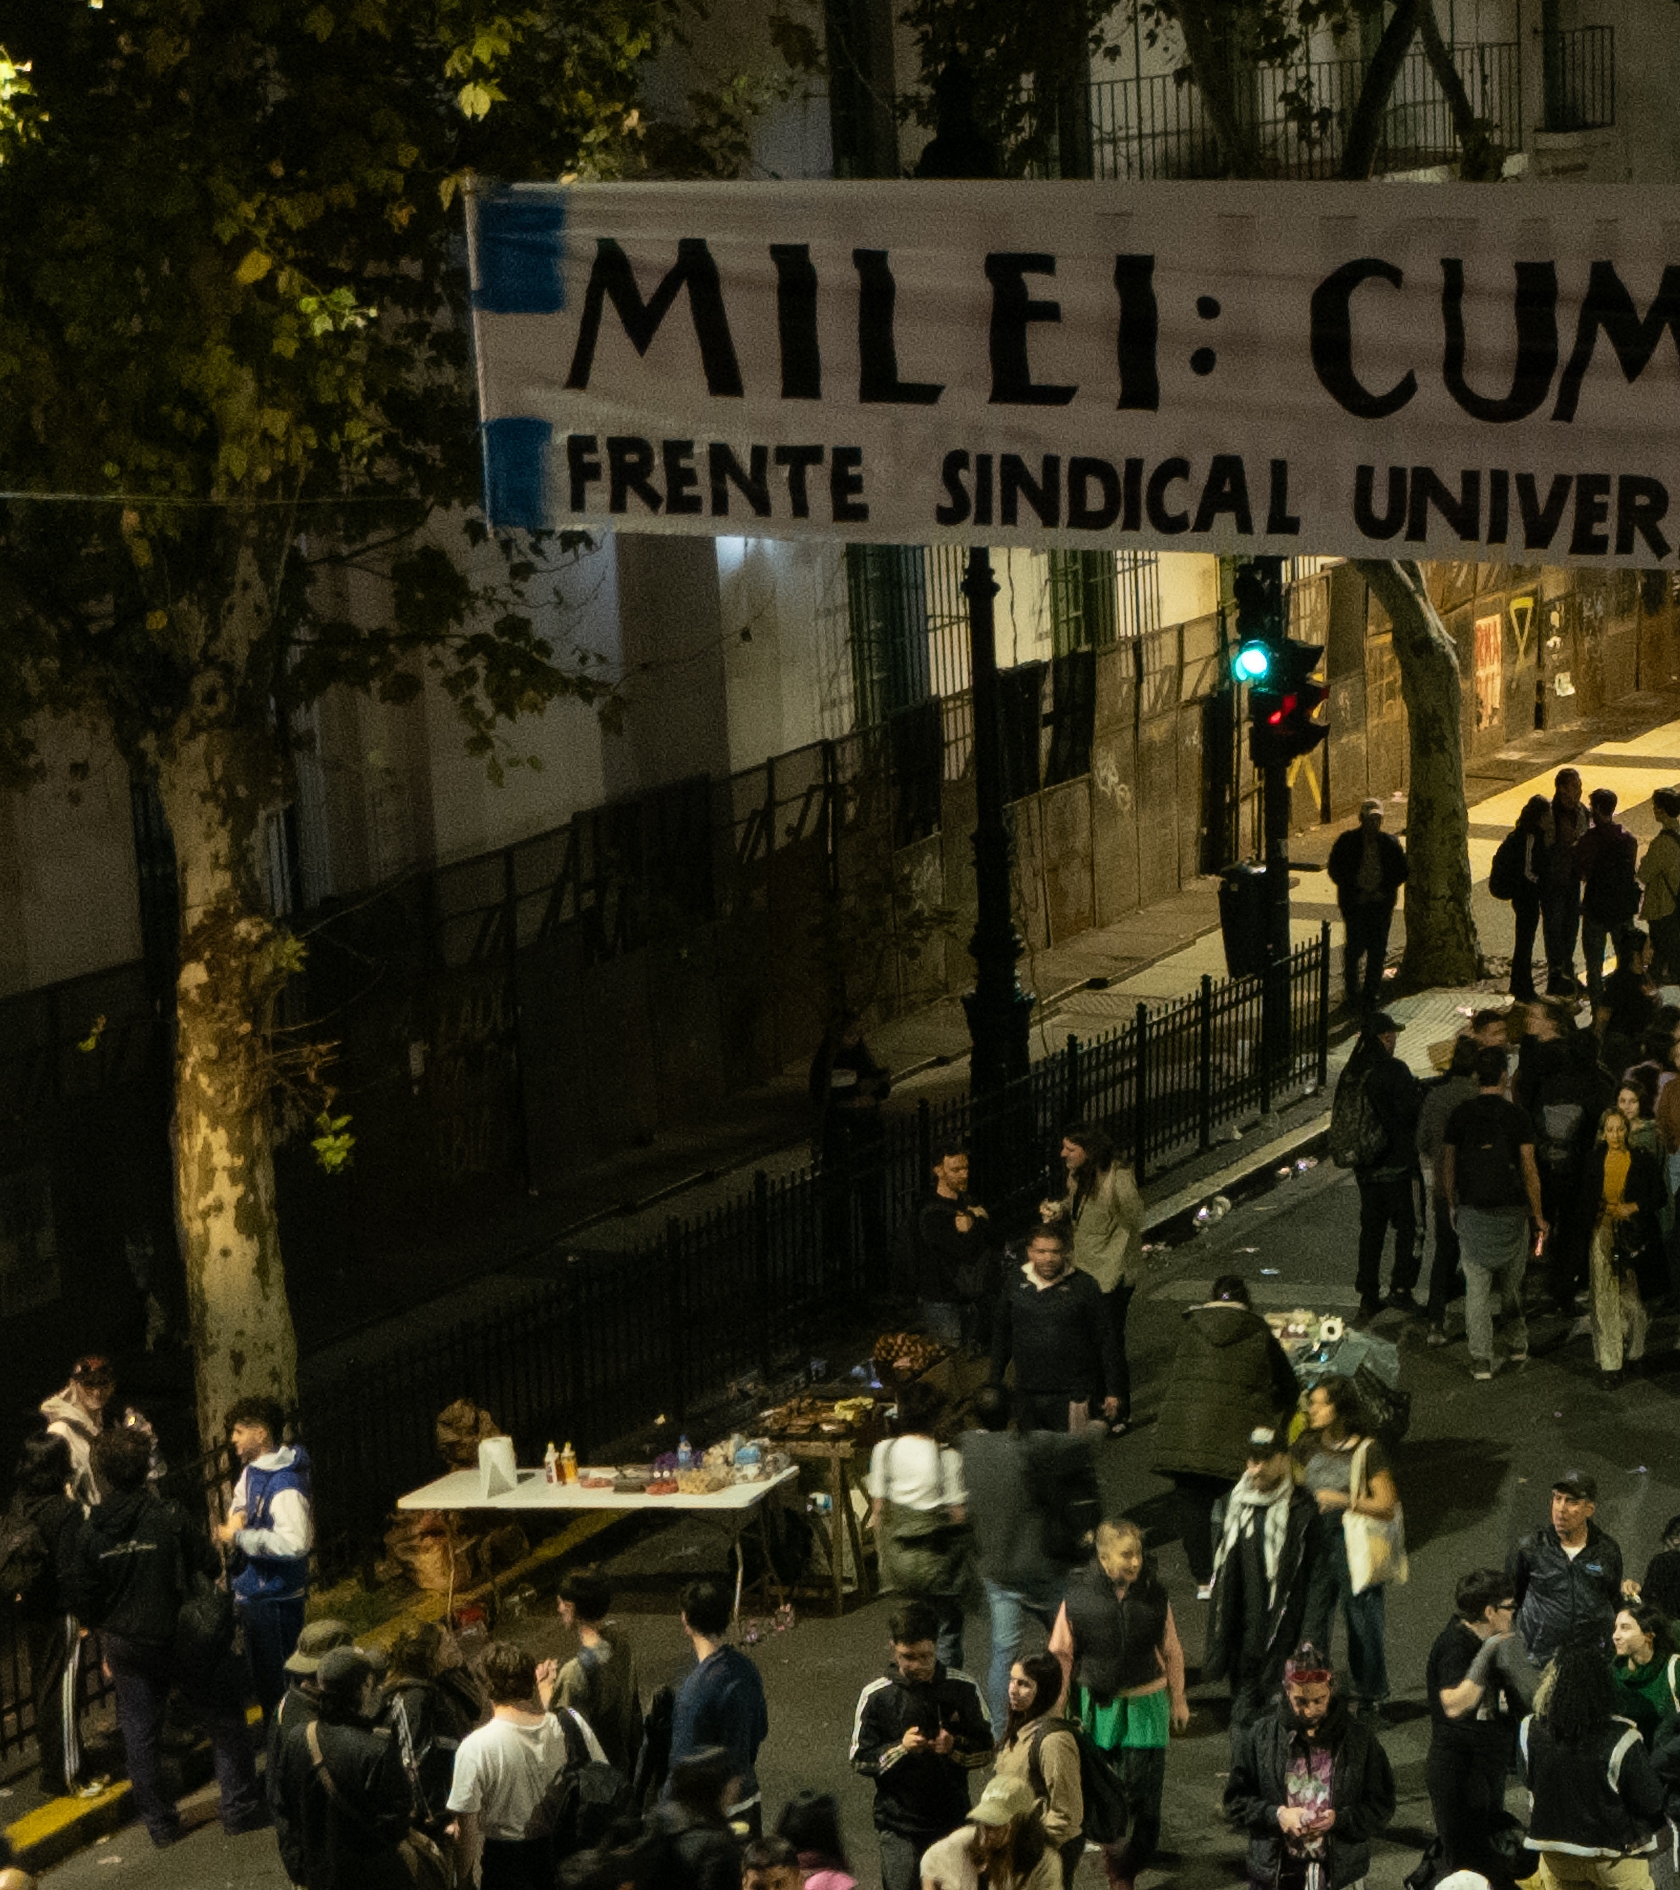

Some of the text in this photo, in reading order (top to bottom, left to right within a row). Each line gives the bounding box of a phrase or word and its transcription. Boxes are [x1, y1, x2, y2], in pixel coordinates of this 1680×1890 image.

[563, 236, 1222, 411] MILEI:
[567, 432, 871, 523] FRENTE
[935, 447, 1302, 536] SINDICAL
